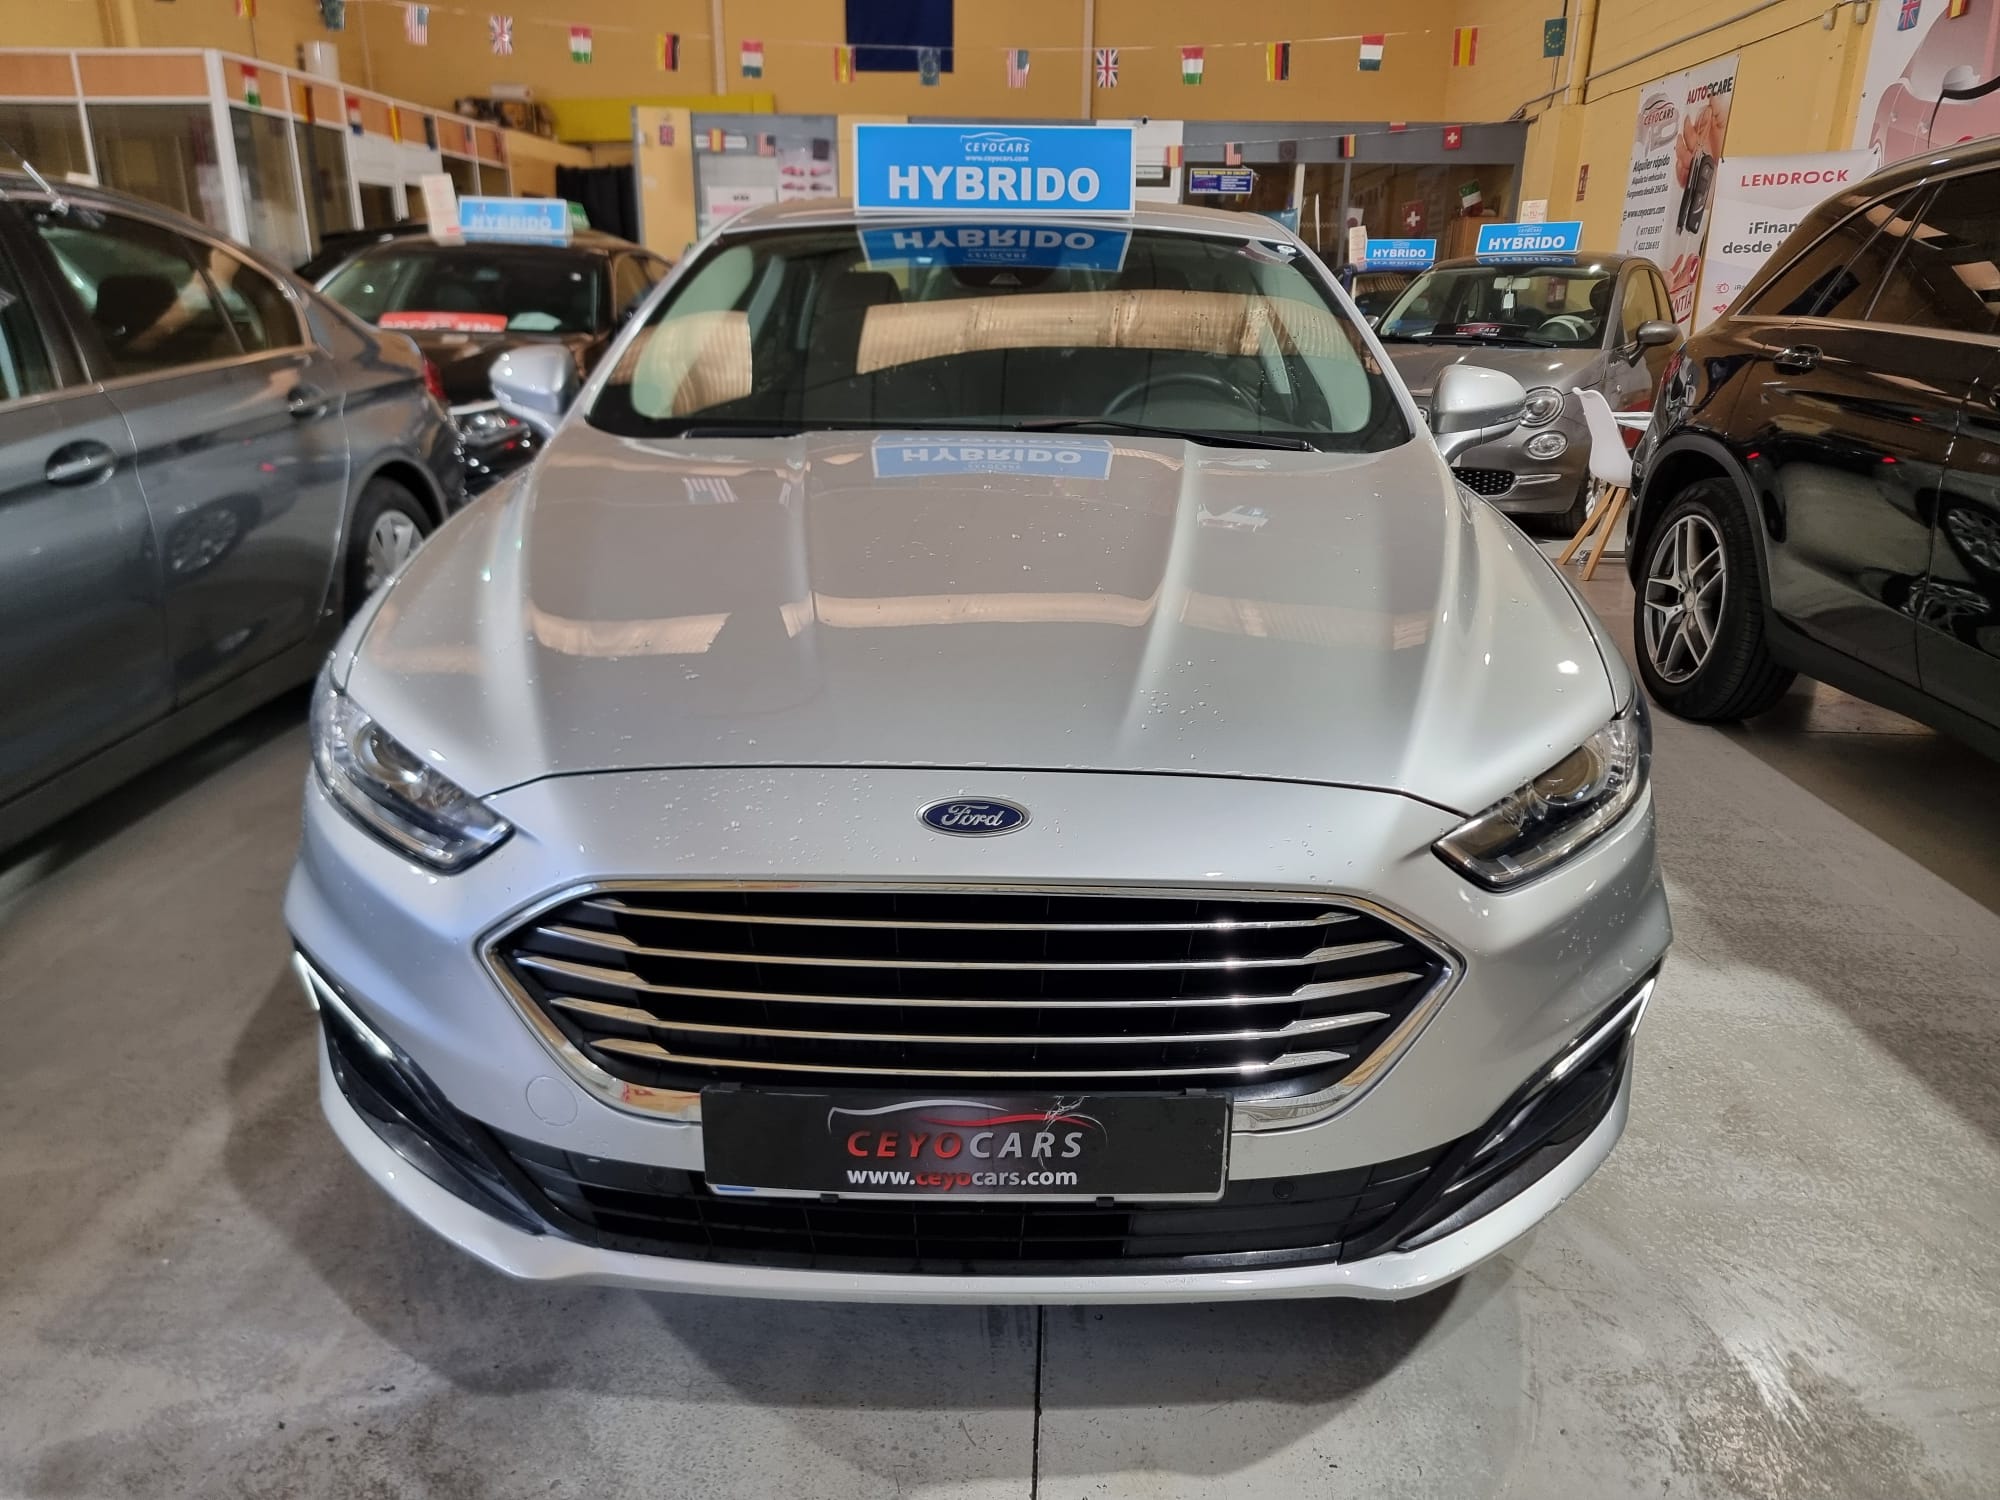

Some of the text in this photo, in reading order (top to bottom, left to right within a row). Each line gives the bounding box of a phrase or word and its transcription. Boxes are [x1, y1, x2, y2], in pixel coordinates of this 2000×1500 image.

[965, 142, 1031, 153] CEYOCARS
[889, 165, 1100, 202] HYBRIDO
[1741, 169, 1850, 187] LENDROCK
[1488, 236, 1566, 250] HYBRIDO
[1722, 240, 1772, 254] desde
[1373, 248, 1426, 258] HYBRIDO
[941, 804, 1005, 826] Ford
[847, 1131, 1083, 1158] CEYOCARS
[847, 1170, 1077, 1190] www.ceyocars.com
